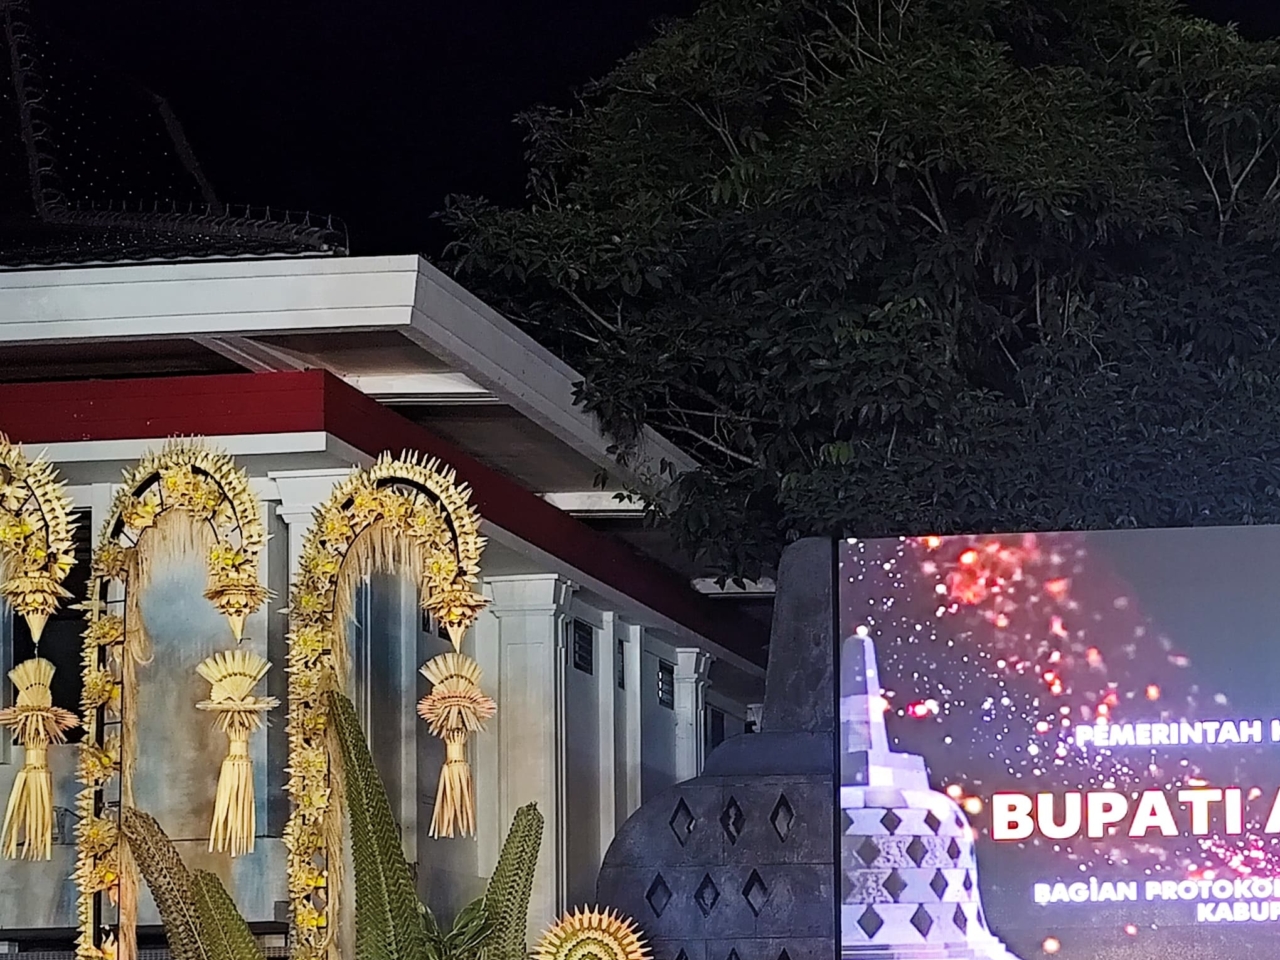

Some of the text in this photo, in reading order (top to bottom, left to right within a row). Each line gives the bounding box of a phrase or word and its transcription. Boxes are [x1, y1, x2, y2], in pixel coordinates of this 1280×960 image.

[1075, 719, 1263, 746] PEMERINTAH
[992, 787, 1243, 840] BUPATI
[1034, 880, 1137, 903] BAGIAN
